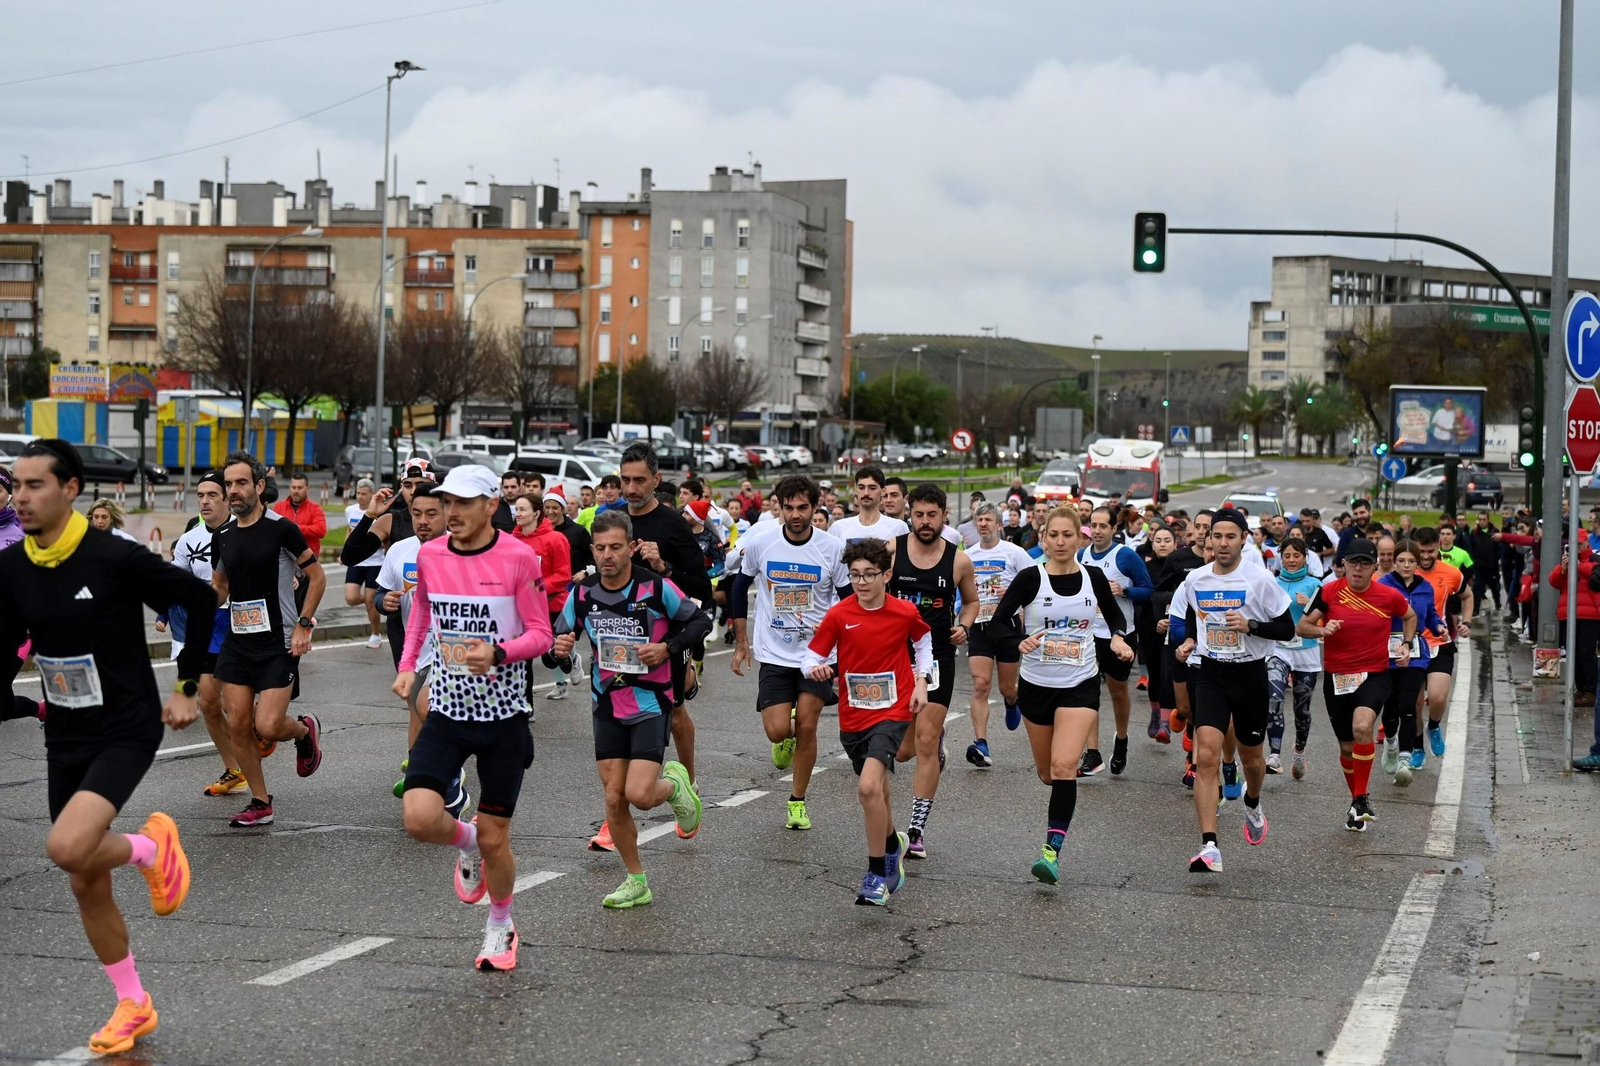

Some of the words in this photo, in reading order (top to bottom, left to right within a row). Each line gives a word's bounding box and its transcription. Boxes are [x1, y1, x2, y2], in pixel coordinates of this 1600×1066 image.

[59, 366, 99, 374] CHURRERIA
[53, 375, 105, 384] CHOCOLATERIA
[1568, 418, 1600, 440] STOP
[774, 591, 808, 606] 212
[430, 601, 491, 619] NTRENA
[439, 618, 499, 634] MEJORA
[1043, 616, 1090, 629] indea
[1206, 630, 1238, 646] 103
[440, 643, 474, 664] 30
[612, 645, 627, 663] 2
[1043, 640, 1080, 657] 355
[53, 671, 69, 695] 1
[1335, 673, 1362, 689] 273
[855, 684, 882, 700] 90
